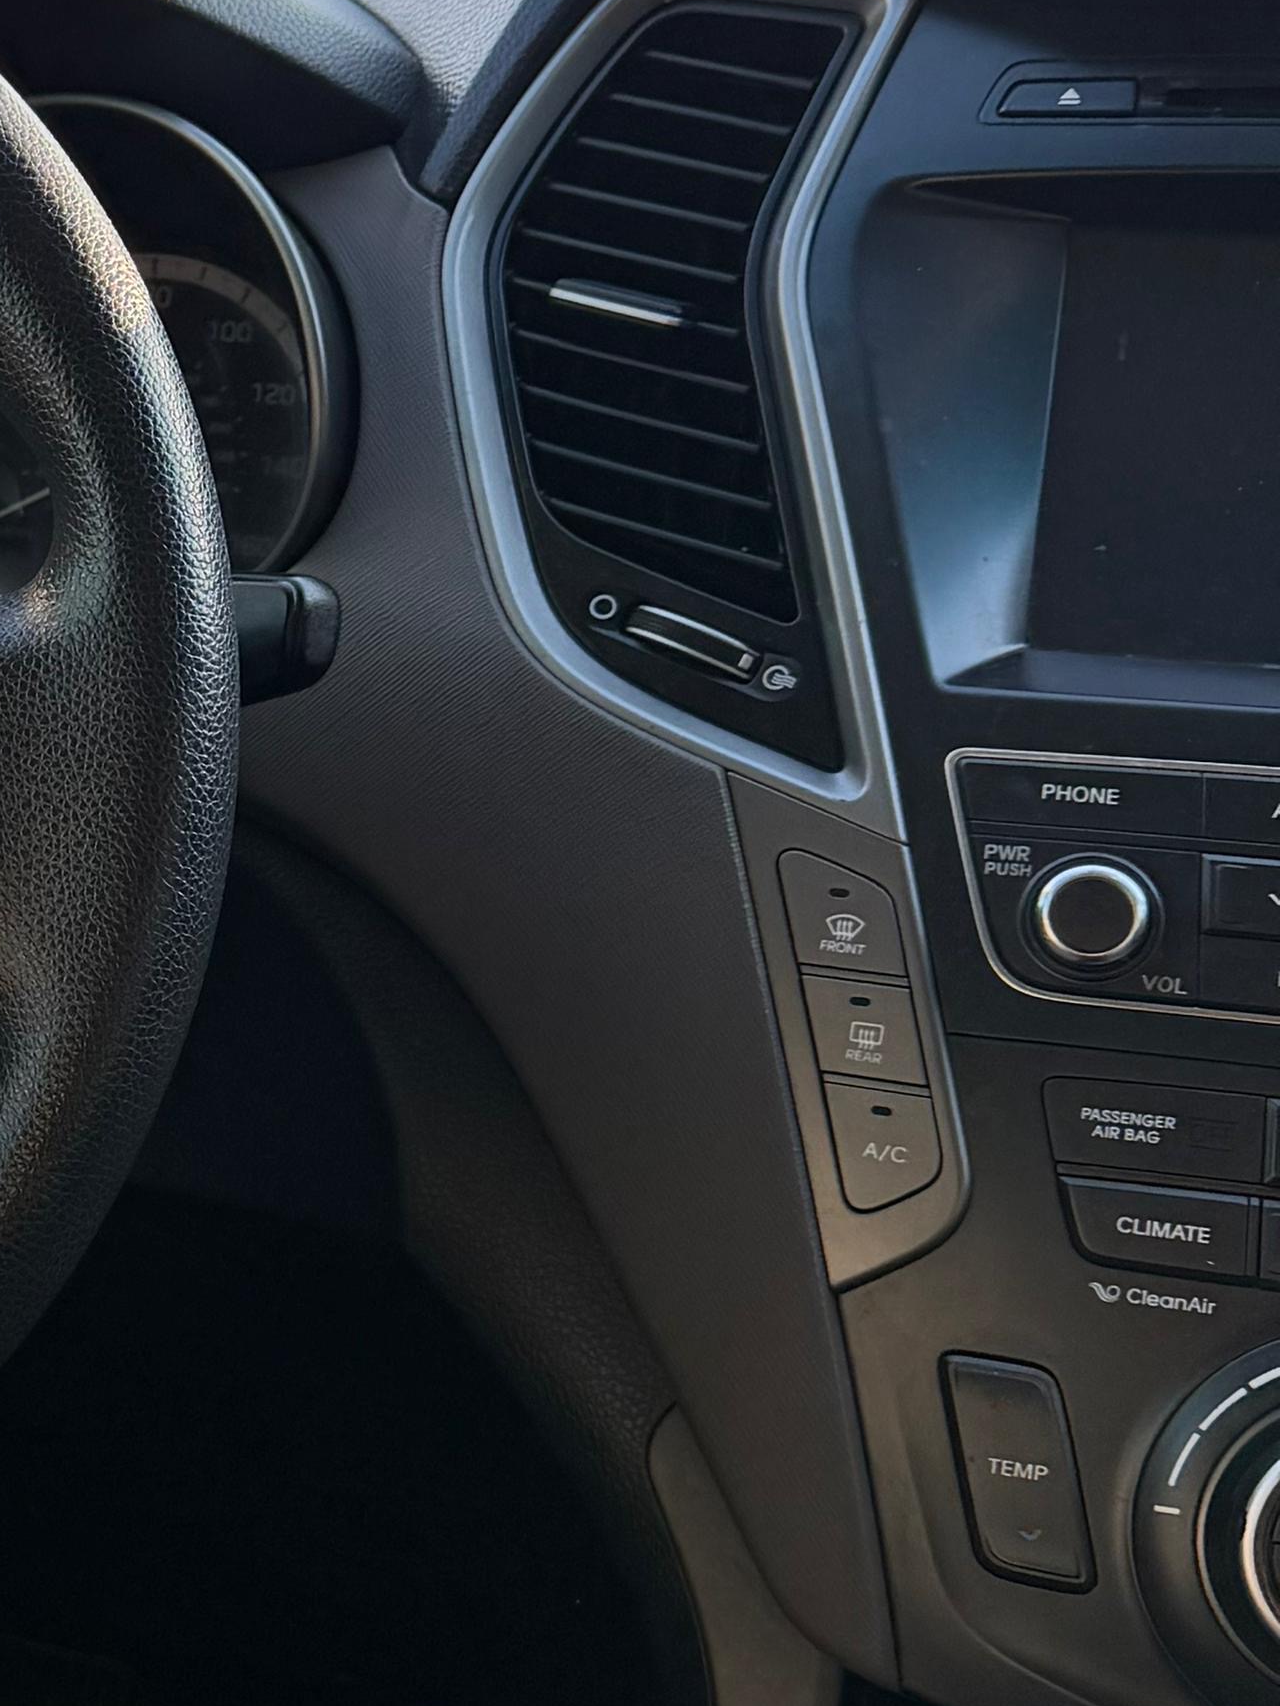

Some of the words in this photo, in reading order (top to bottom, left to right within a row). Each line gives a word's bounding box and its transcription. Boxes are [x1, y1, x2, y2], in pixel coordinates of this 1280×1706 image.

[1041, 783, 1120, 806] PHONE
[984, 843, 1031, 863] PWR
[984, 861, 1032, 877] PUSH
[819, 939, 866, 955] FRONT
[1142, 974, 1187, 994] VOL
[845, 1049, 882, 1065] REAR
[1080, 1107, 1176, 1130] PASSENGER
[1091, 1125, 1120, 1140] AIR
[1124, 1127, 1161, 1145] BAG
[862, 1142, 907, 1164] A/C
[1116, 1216, 1211, 1244] CLIMATE
[1126, 1287, 1217, 1316] CleanAir
[988, 1457, 1049, 1482] TEMP
